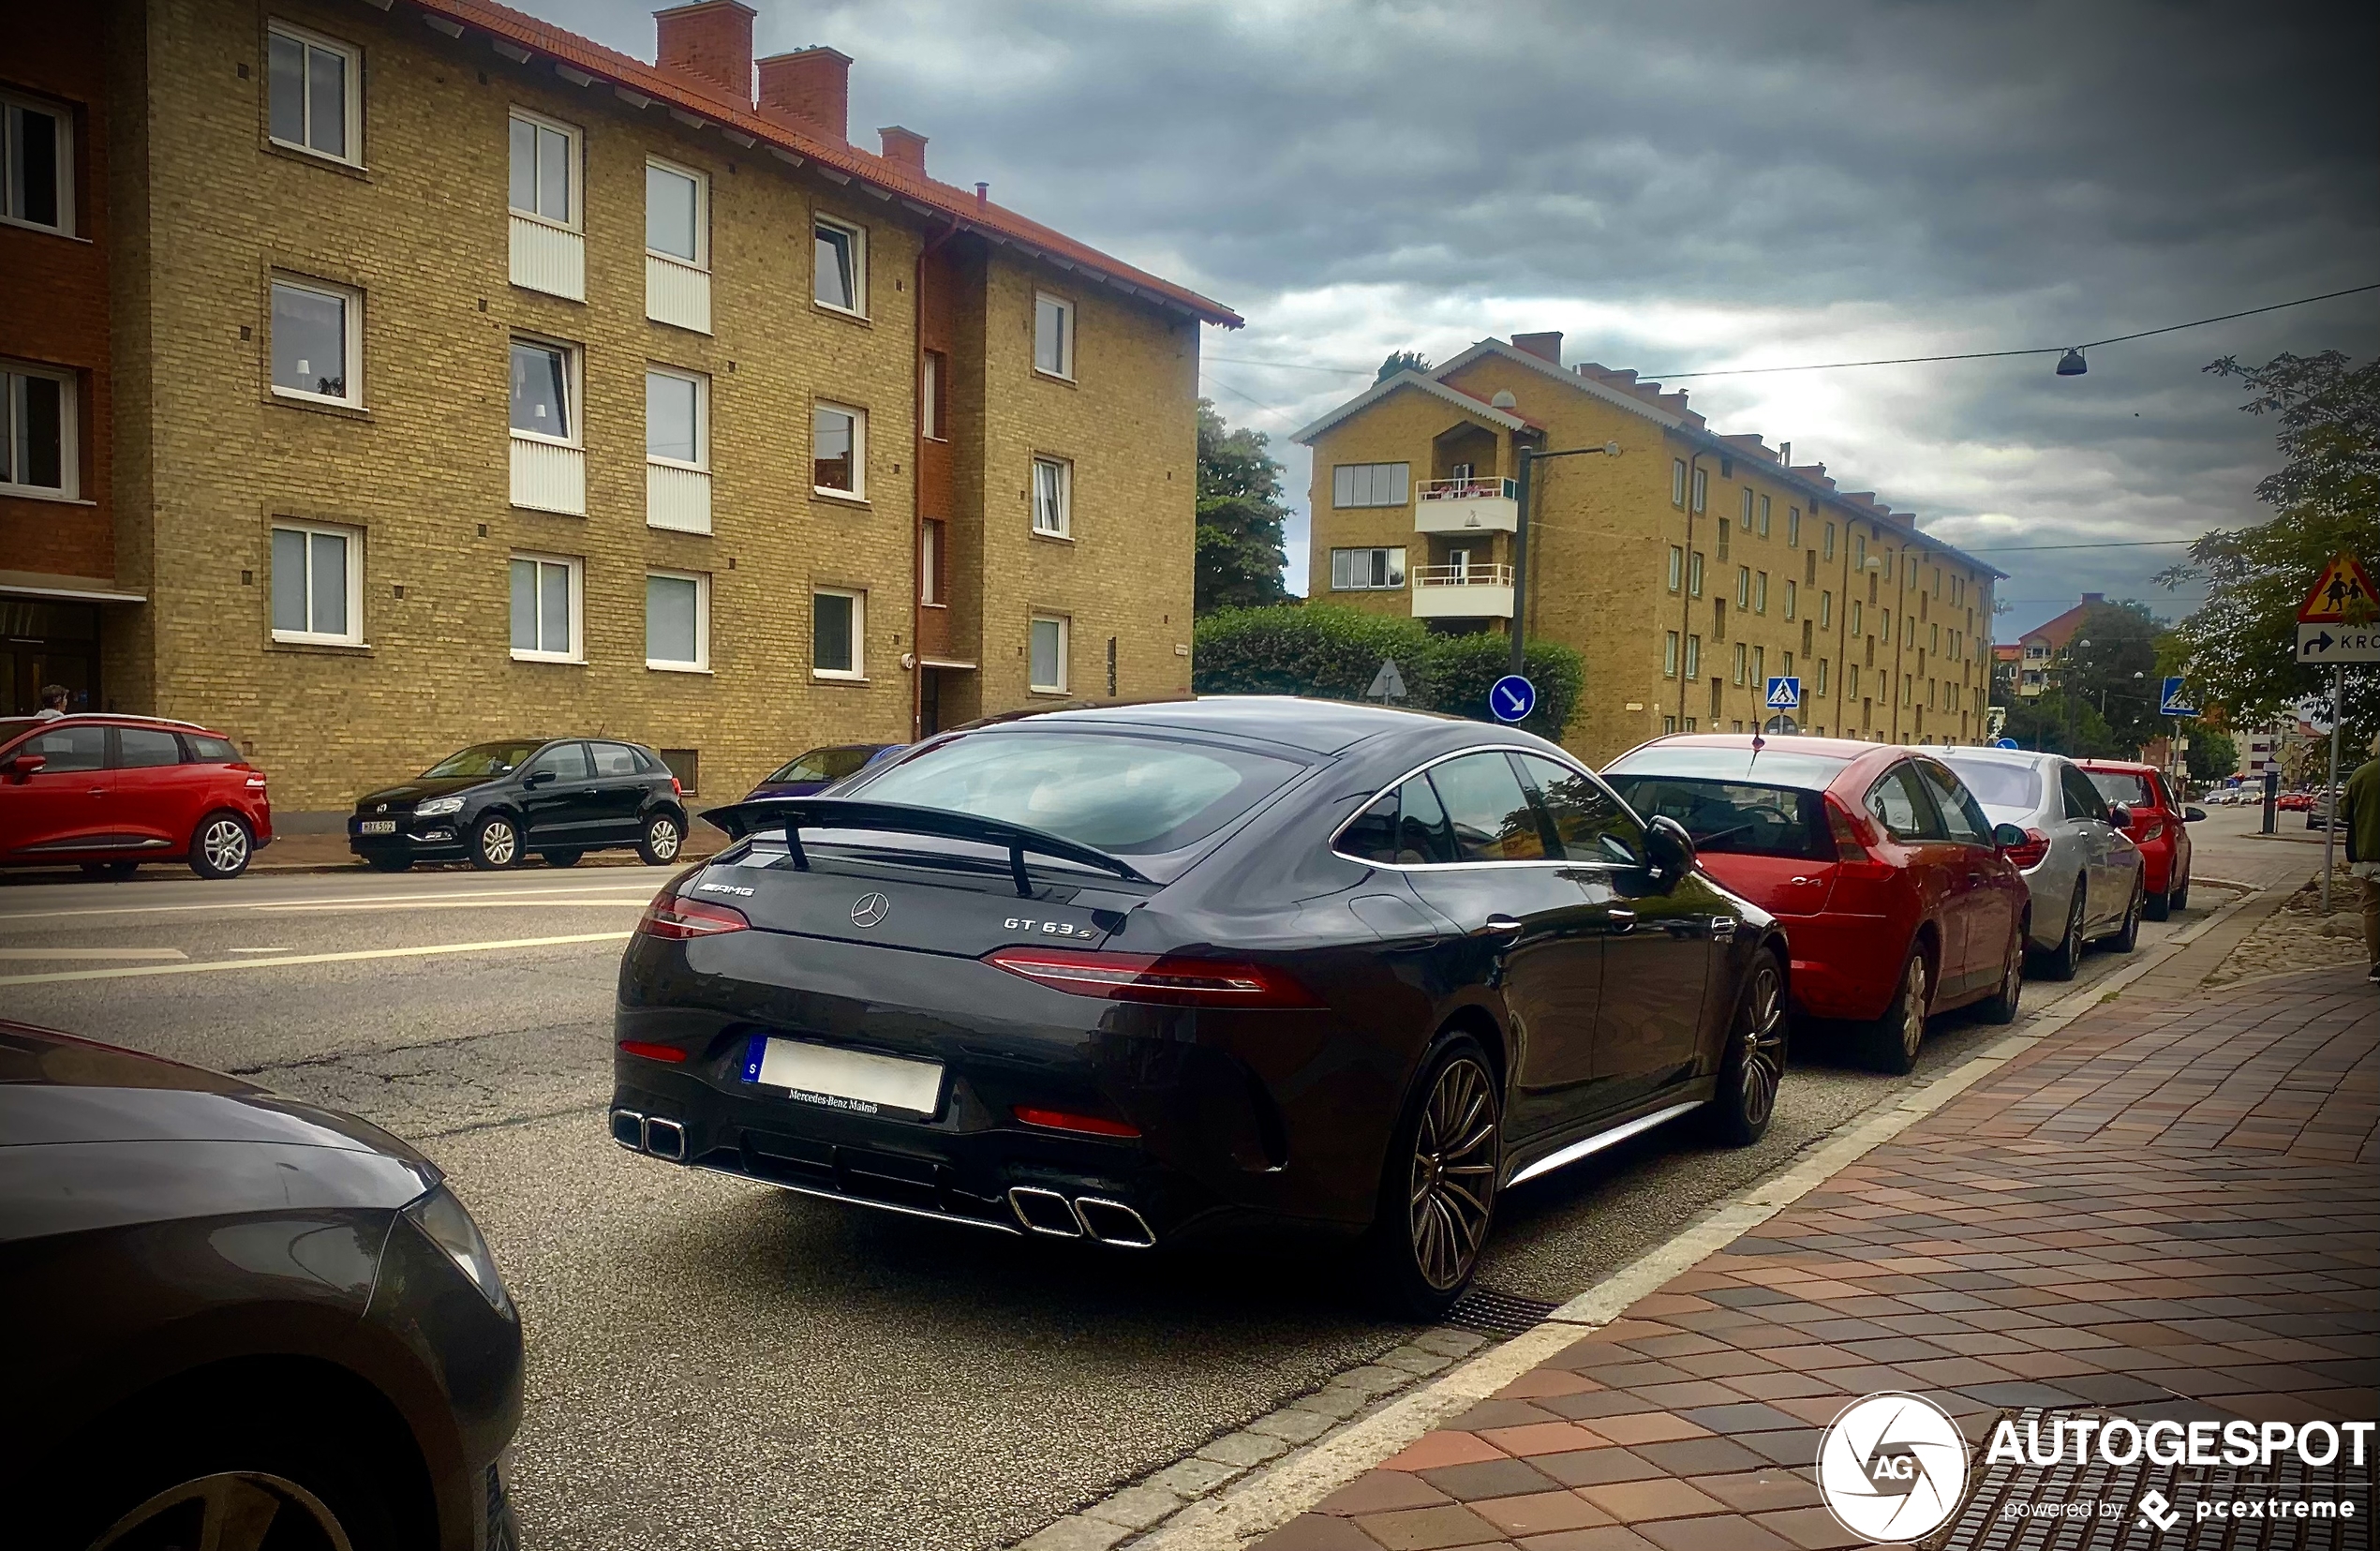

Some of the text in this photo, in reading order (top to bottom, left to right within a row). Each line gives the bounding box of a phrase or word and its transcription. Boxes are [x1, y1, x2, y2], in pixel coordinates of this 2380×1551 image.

[379, 821, 394, 831] 502
[715, 885, 755, 897] AMG
[1004, 917, 1036, 931] GT
[749, 1063, 757, 1074] S
[789, 1088, 879, 1114] Mercedes-Benz Malmö
